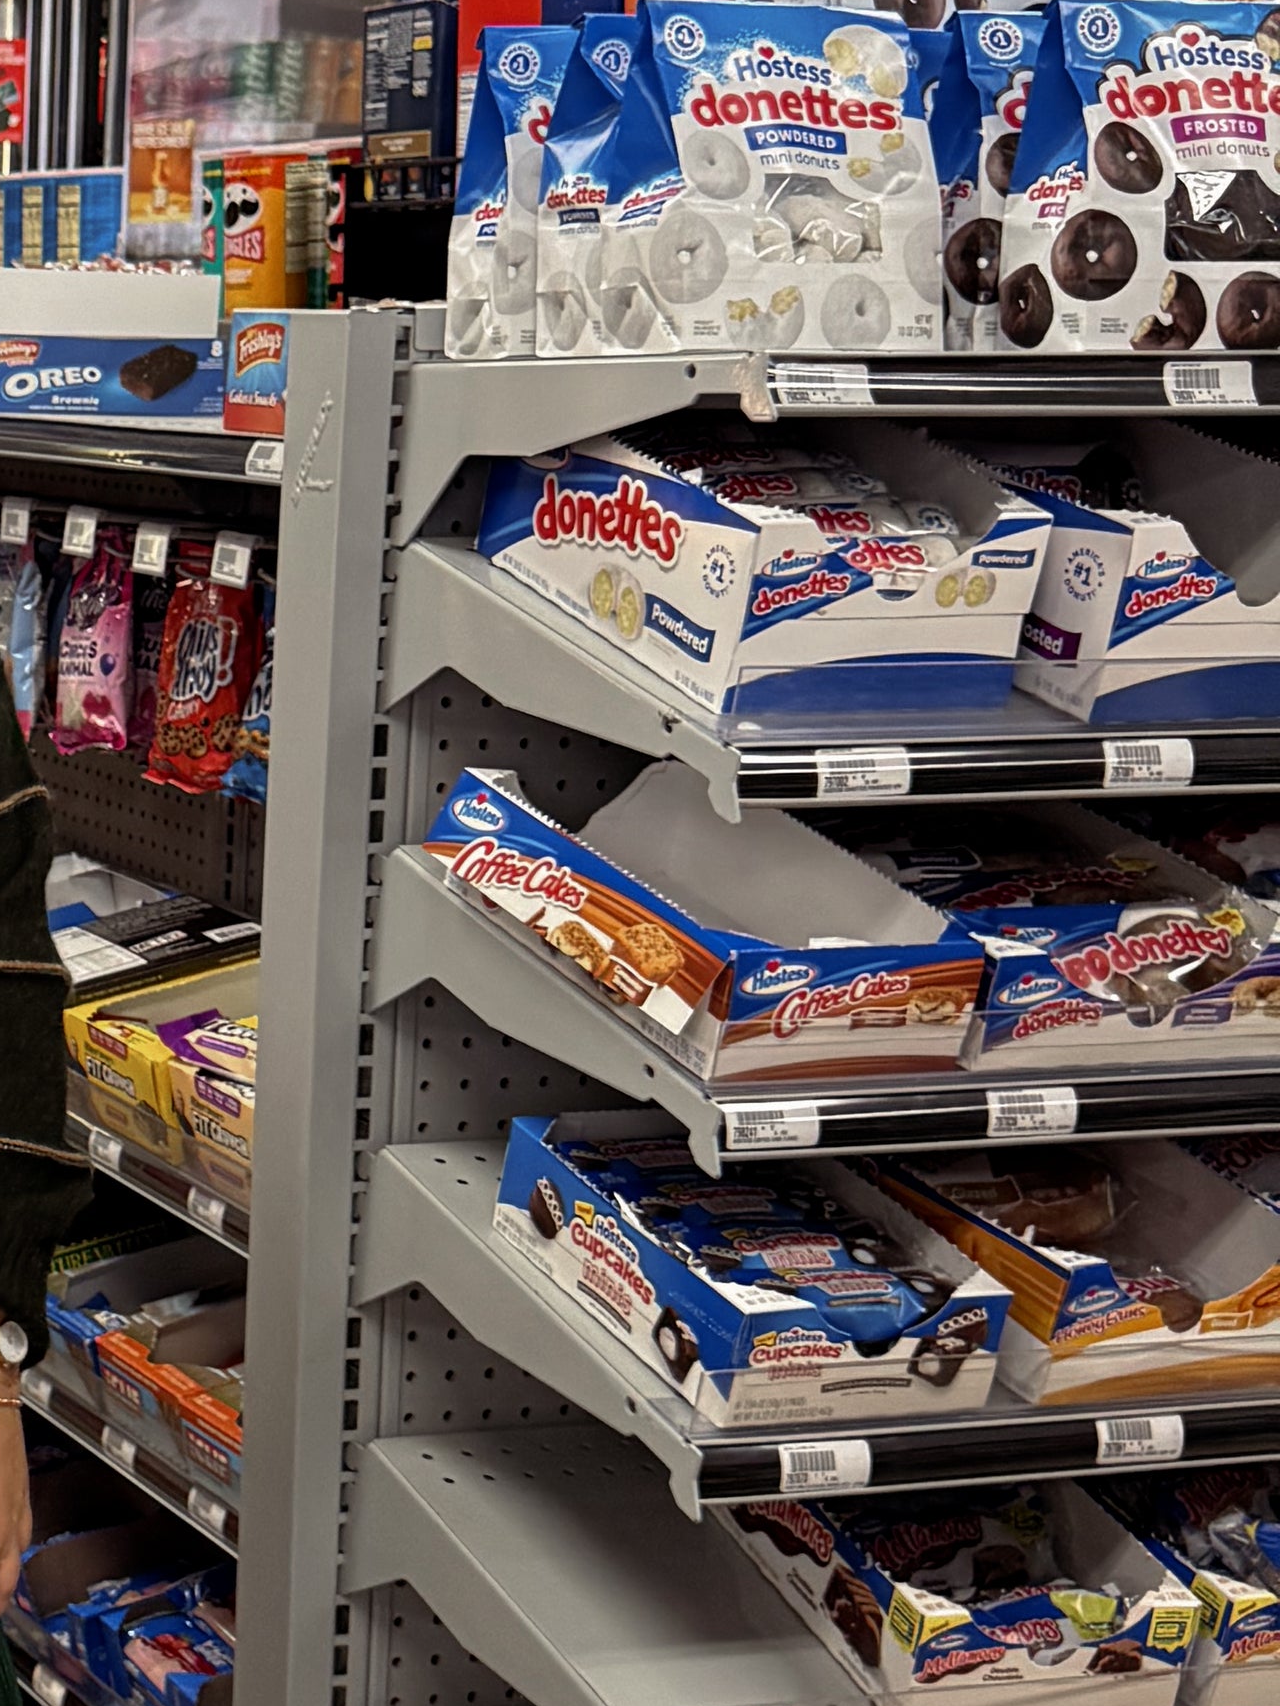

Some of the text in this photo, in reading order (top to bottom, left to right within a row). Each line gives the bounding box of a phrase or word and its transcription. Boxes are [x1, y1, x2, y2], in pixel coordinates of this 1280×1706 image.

[735, 54, 832, 87] Hostess
[1153, 42, 1265, 72] Hostess
[690, 85, 898, 131] donettes
[755, 128, 837, 150] POWDERED
[1183, 120, 1259, 137] FROSTED
[760, 150, 840, 172] mini donuts
[1175, 140, 1270, 160] mini donuts
[2, 366, 102, 399] OREO
[535, 475, 681, 564] donettes
[978, 552, 1028, 567] Powdered
[1072, 561, 1091, 587] #1
[752, 573, 850, 615] donettes
[1126, 574, 1217, 617] donettes
[651, 602, 710, 655] Powdered
[451, 836, 586, 911] Coffee Cakes
[1106, 919, 1233, 972] donettes
[752, 963, 811, 992] Hostess
[772, 971, 911, 1040] Coffee Cakes
[86, 1054, 102, 1079] FIT
[570, 1220, 654, 1307] Cupcakes
[581, 1257, 633, 1316] minis
[778, 1331, 824, 1345] Hostess
[1054, 1305, 1146, 1344] Honey Buns
[752, 1342, 842, 1363] Cupcakes
[767, 1361, 822, 1382] minis
